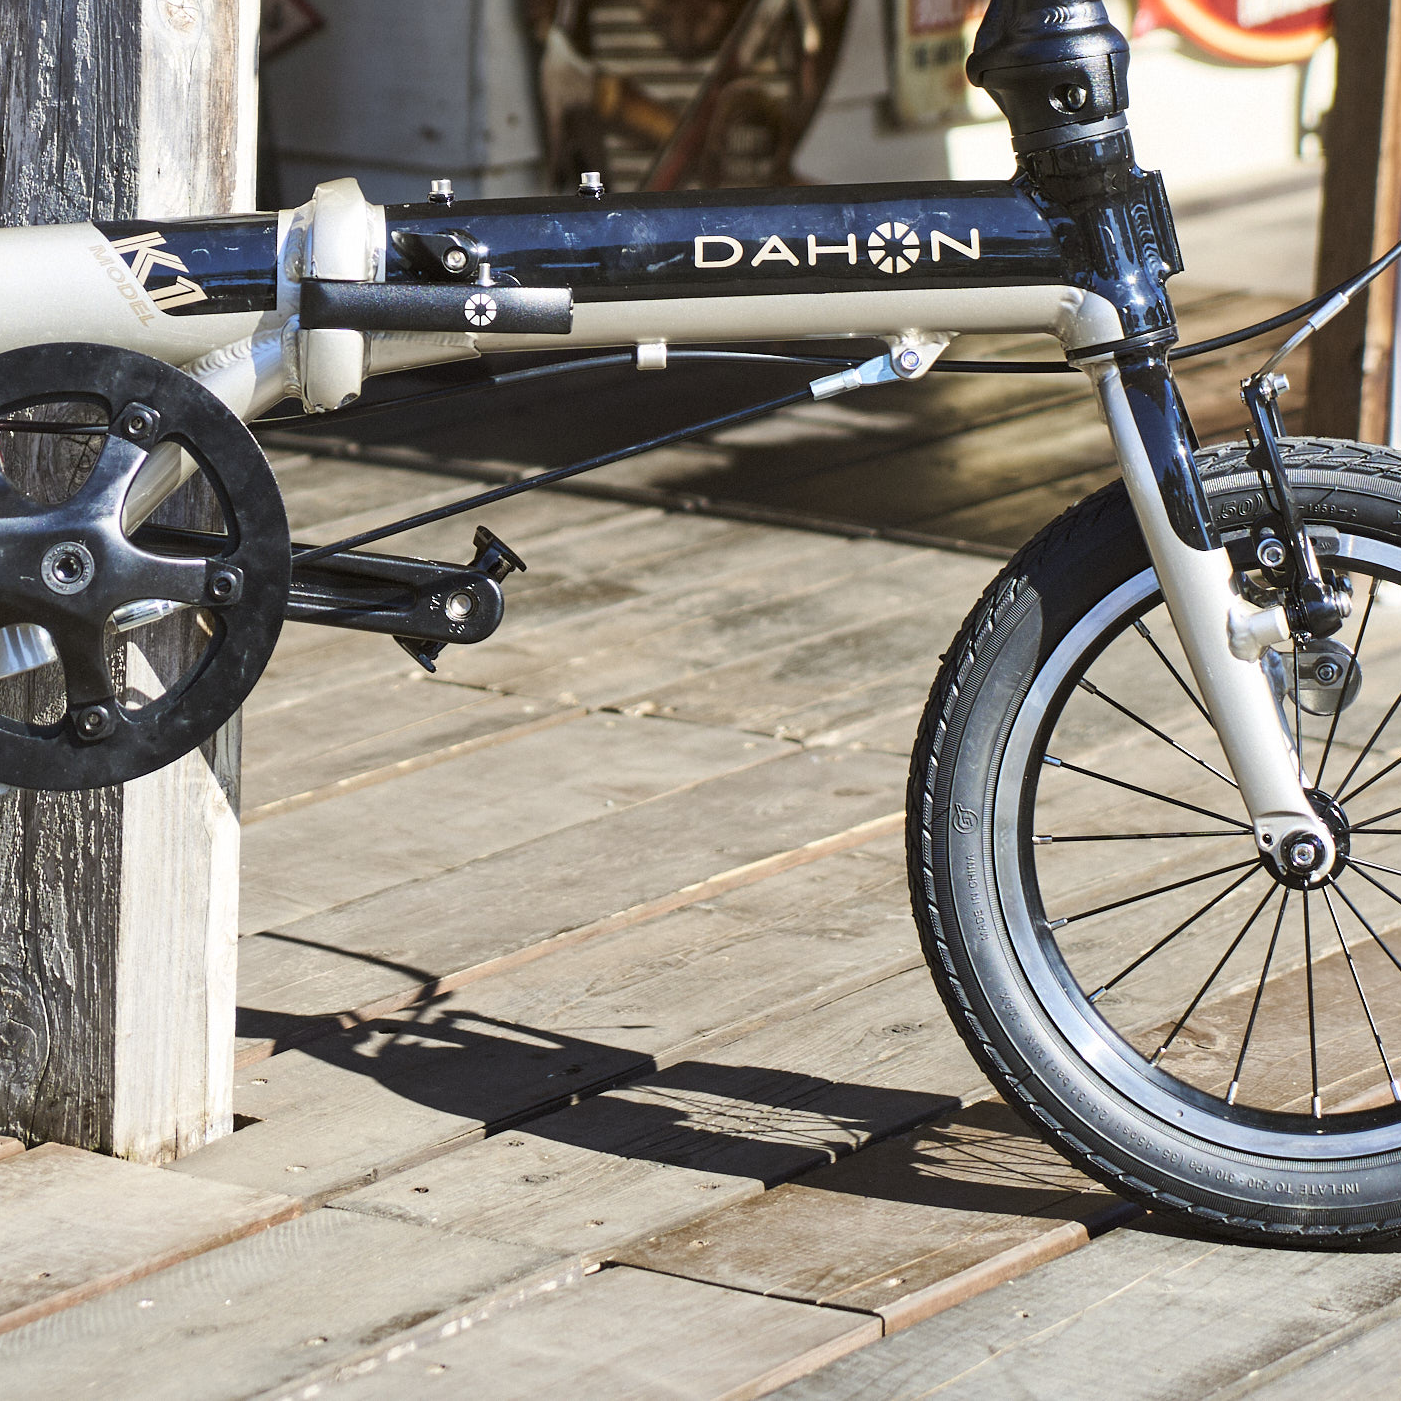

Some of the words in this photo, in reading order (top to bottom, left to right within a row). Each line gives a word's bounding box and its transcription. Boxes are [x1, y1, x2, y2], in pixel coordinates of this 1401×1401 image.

[109, 230, 209, 312] K1
[694, 220, 981, 275] DAHON
[88, 243, 156, 328] MODEL
[1273, 1180, 1294, 1196] TO
[1298, 1180, 1360, 1197] INFLATE
